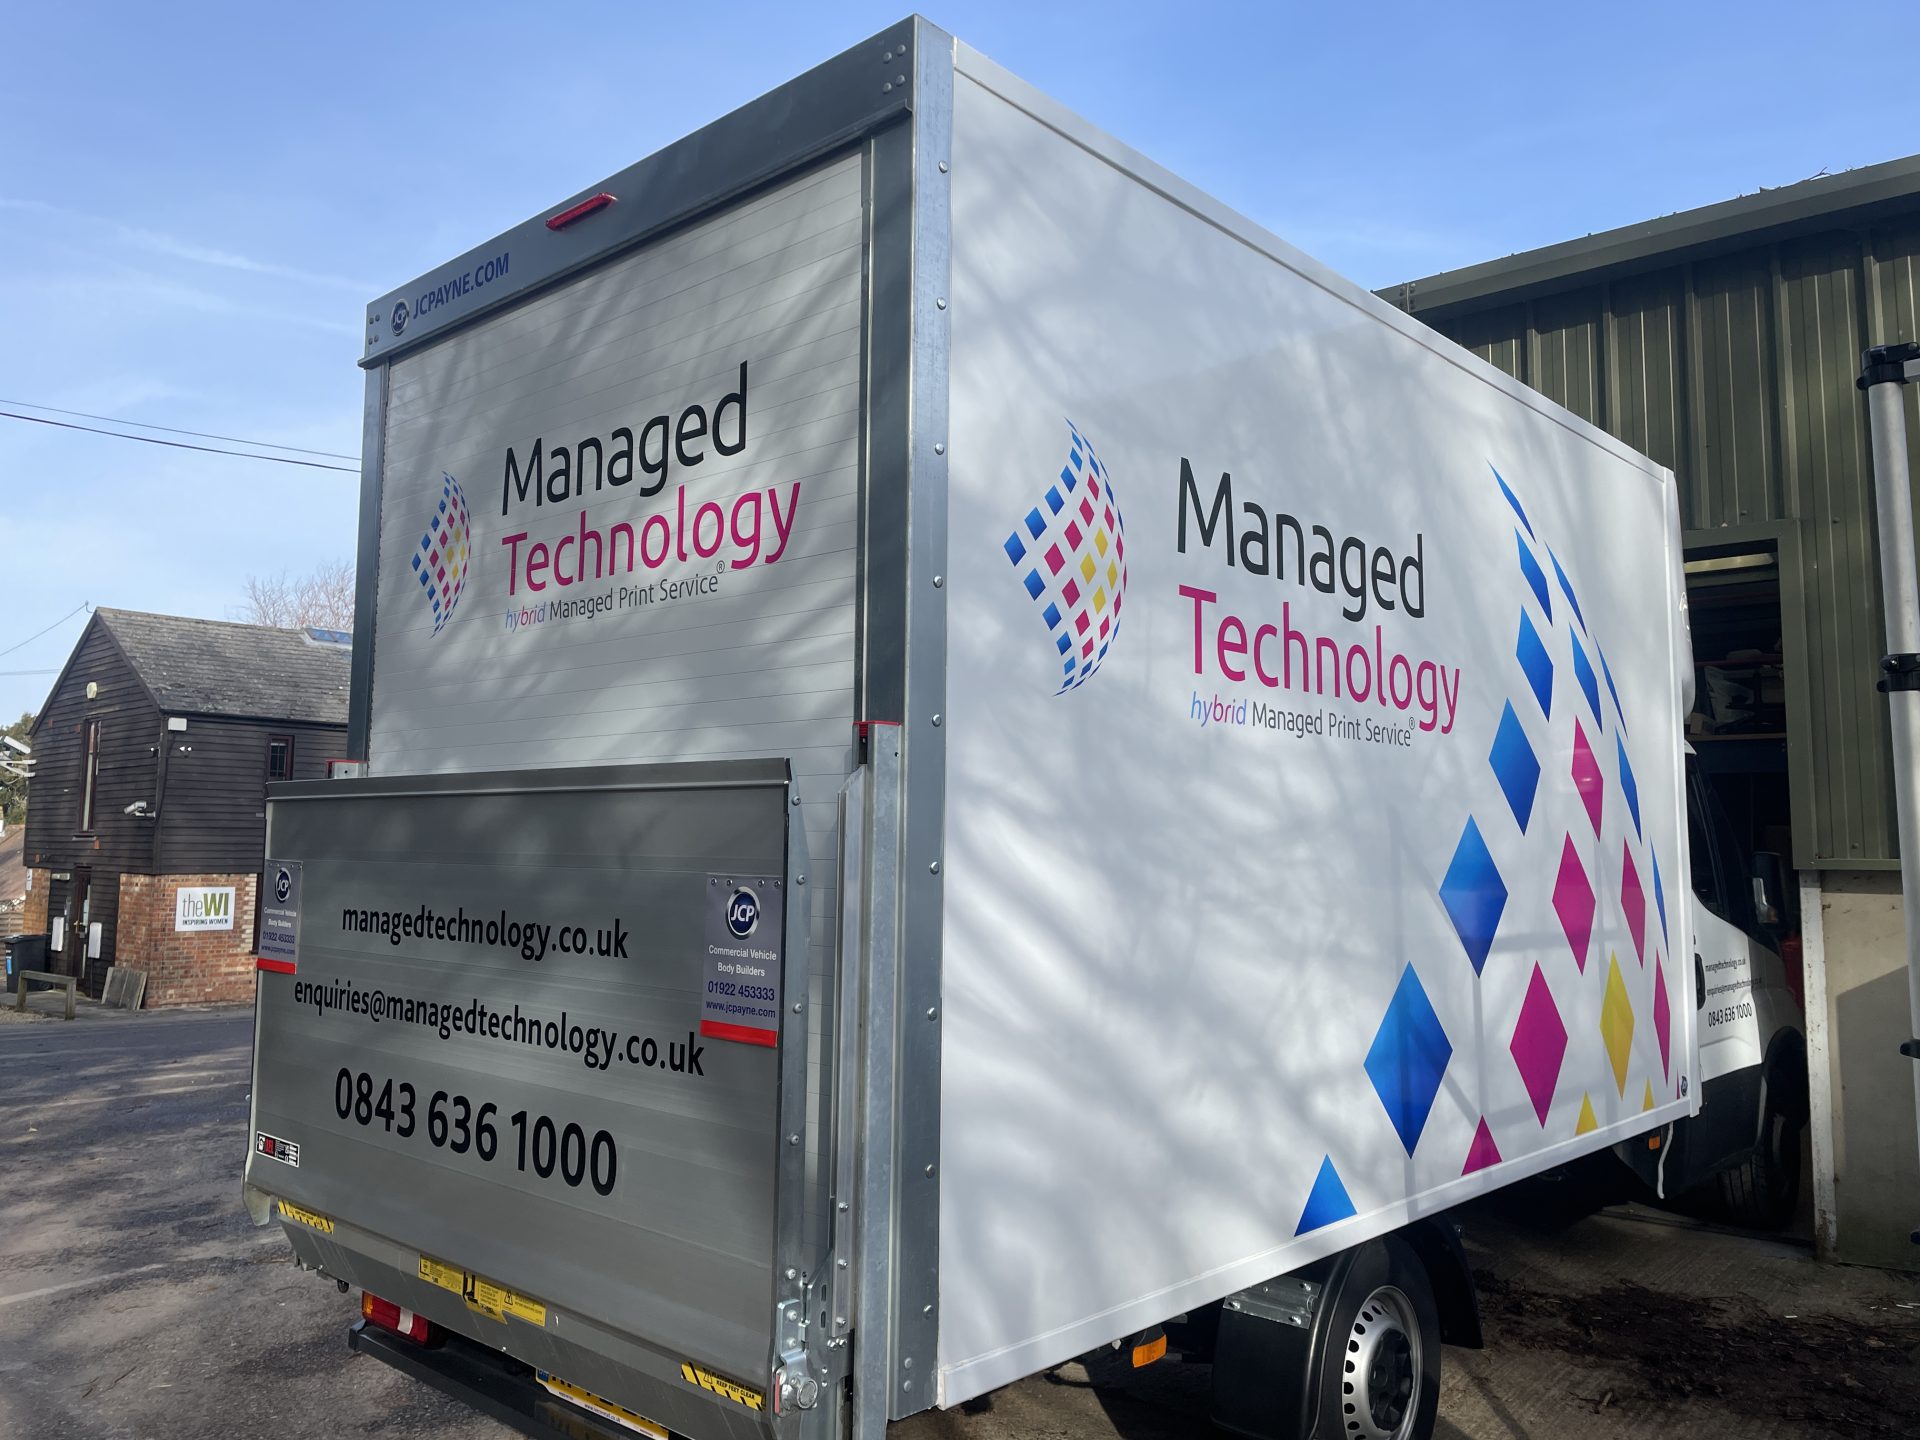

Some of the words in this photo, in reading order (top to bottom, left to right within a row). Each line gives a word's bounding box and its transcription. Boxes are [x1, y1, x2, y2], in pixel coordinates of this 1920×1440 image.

[413, 252, 509, 319] JCPAYNE.COM
[501, 360, 748, 516] Managed
[502, 481, 801, 595] Technology
[1177, 456, 1425, 623] Managed
[505, 602, 546, 632] hybrid
[549, 587, 613, 621] Managed
[619, 584, 654, 609] Print
[1178, 584, 1460, 735] Technology
[1190, 691, 1247, 727] hybrid
[1252, 701, 1323, 739] Managed
[1328, 712, 1361, 741] Print
[342, 904, 630, 962] managedtechnology.co.uk
[730, 904, 755, 923] JCP
[708, 944, 749, 958] Commercial
[750, 948, 777, 961] Vehicle
[717, 962, 735, 975] Body
[736, 964, 766, 977] Builders
[705, 1001, 776, 1019] www.jcpayne.com
[707, 980, 736, 997] 01922
[738, 984, 776, 1001] 453333
[1708, 1009, 1723, 1027] 0843
[1724, 1006, 1736, 1023] 636
[1736, 1002, 1752, 1019] 1000
[294, 978, 705, 1077] enquiries@managedtechnology.co.uk
[335, 1067, 417, 1138] 0843
[427, 1090, 498, 1162] 636
[511, 1110, 617, 1196] 1000
[716, 1380, 728, 1388] KEEP
[728, 1384, 740, 1394] FEET
[740, 1389, 755, 1400] CLEAR
